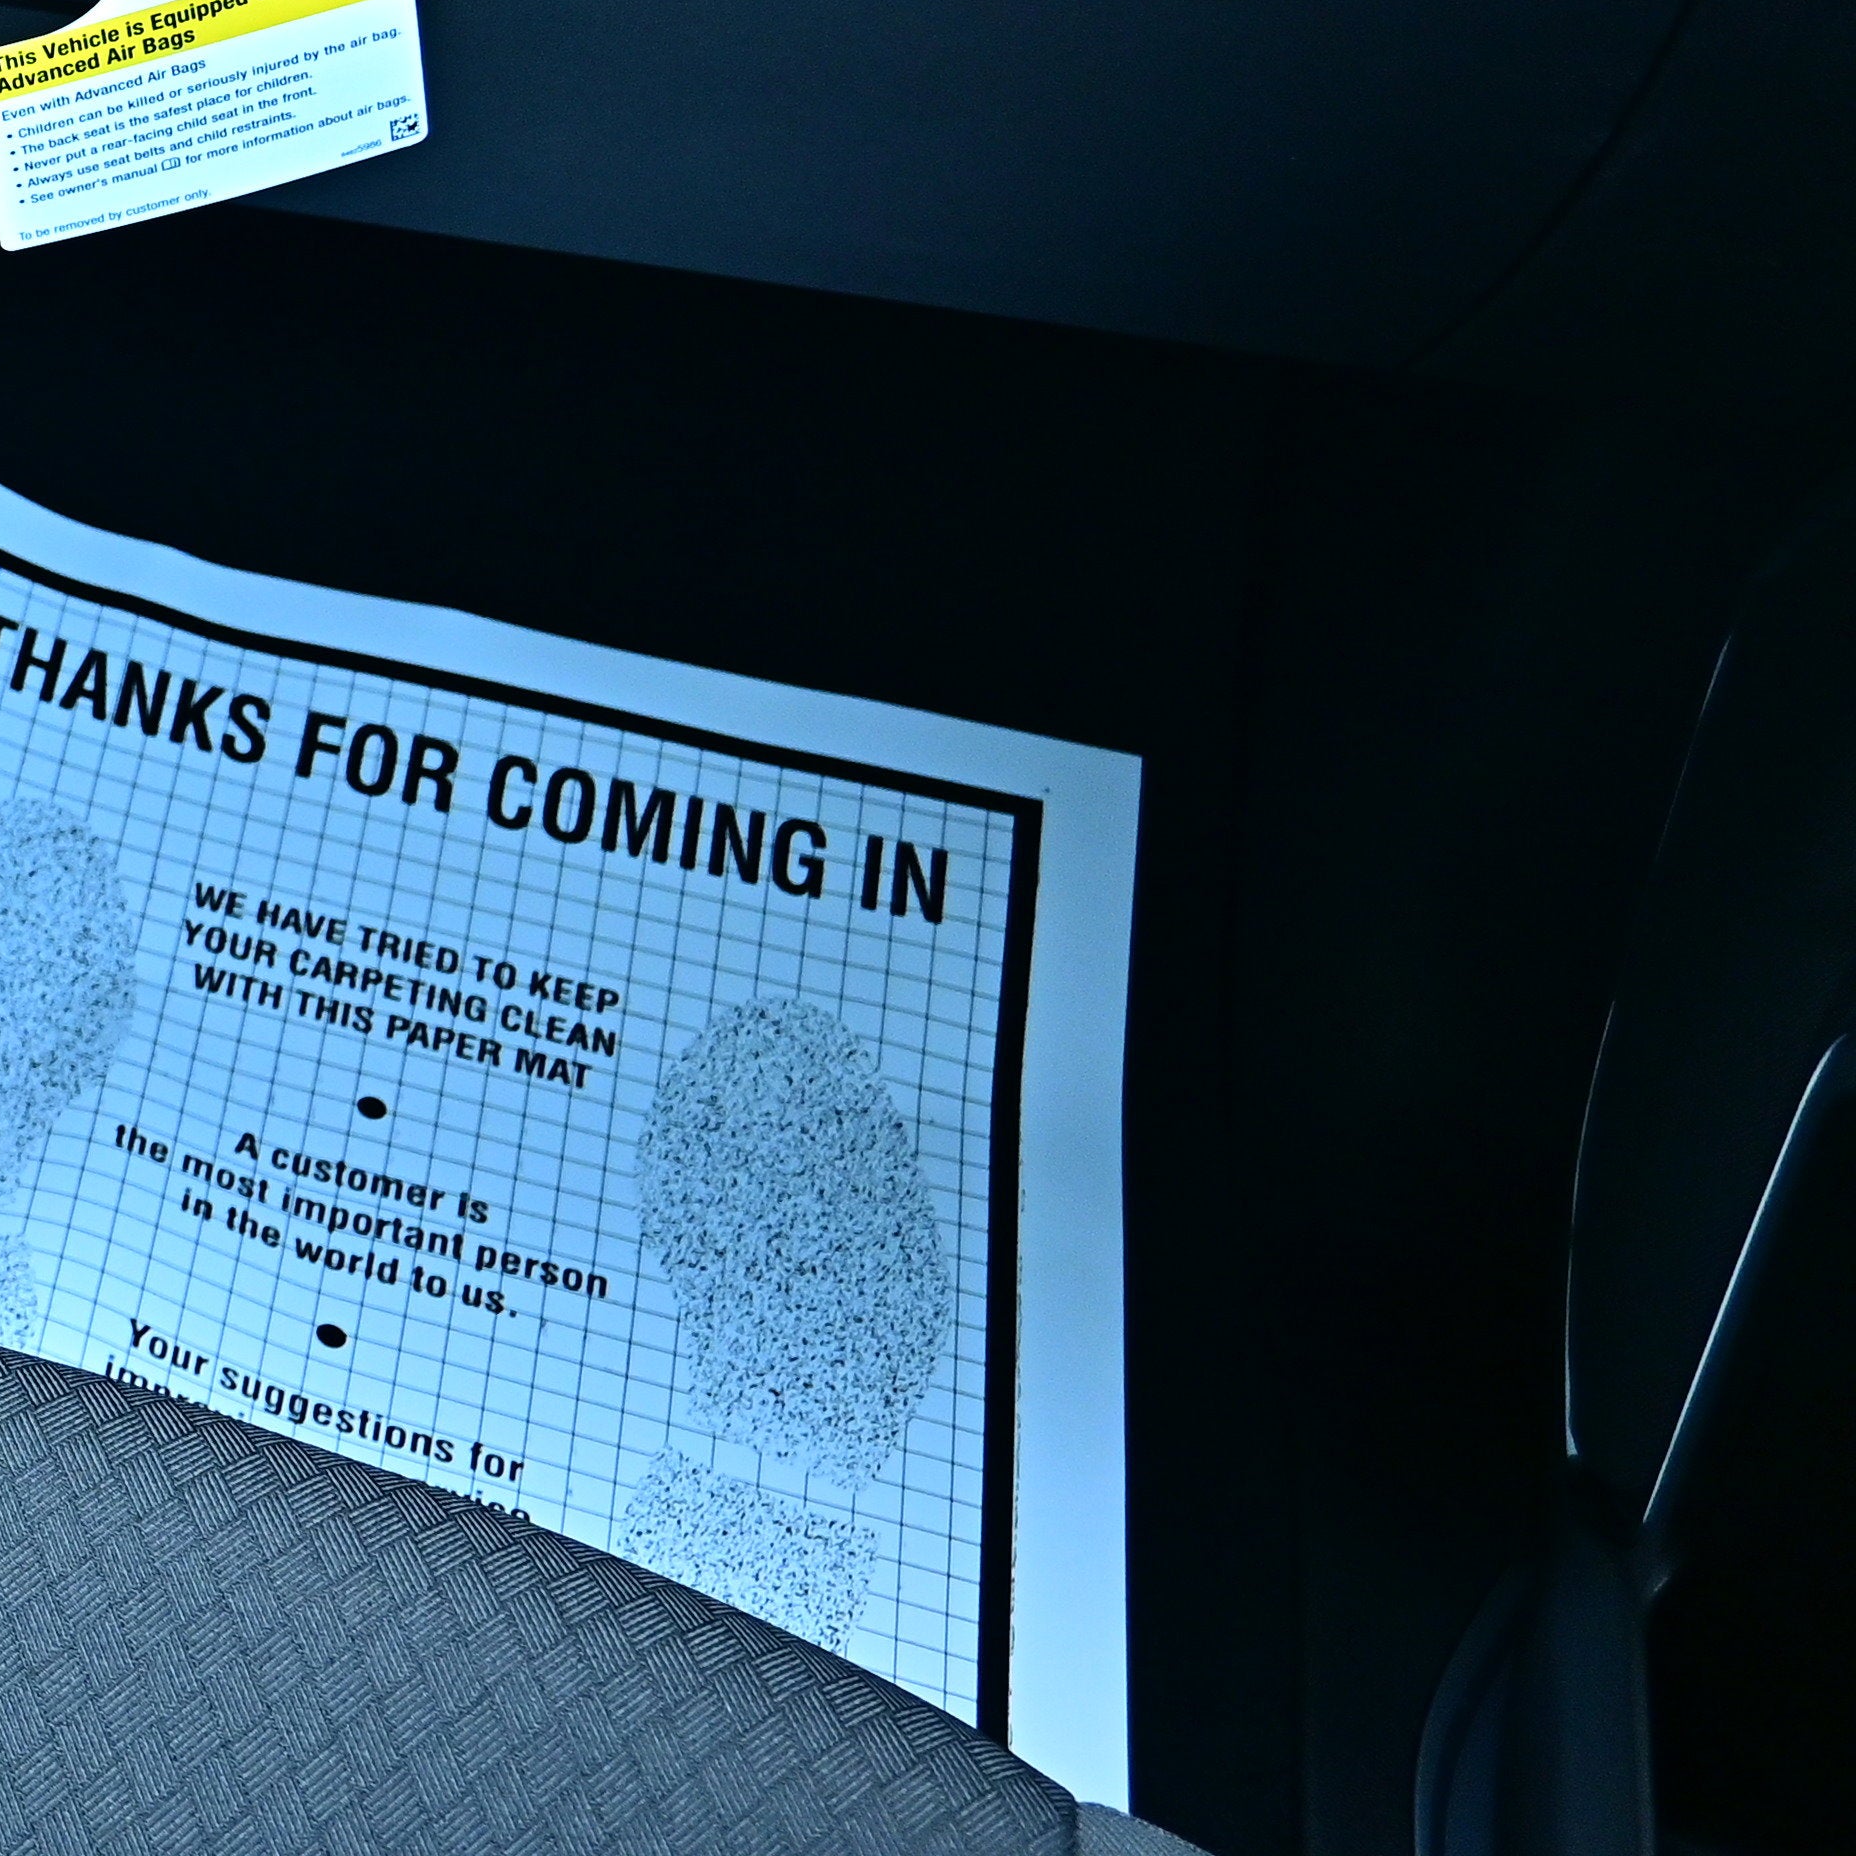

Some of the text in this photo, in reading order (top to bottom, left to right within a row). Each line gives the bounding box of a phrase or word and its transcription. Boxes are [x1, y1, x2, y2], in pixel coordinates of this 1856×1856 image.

[1, 59, 206, 122] Even with Advanced Air Bags
[18, 26, 402, 139] Children can be killed or seriously injured by the air bag.
[42, 28, 119, 59] Vehicle
[125, 21, 145, 37] is
[107, 44, 136, 65] Air
[142, 29, 196, 55] Bags
[21, 70, 313, 156] The back seat is the safest place for children.
[24, 87, 317, 172] Never put a rear-facing child seat in the front.
[27, 111, 296, 189] Always use seat belts and child restraints.
[30, 95, 411, 205] See owner's manual for more information about air bags.
[19, 187, 212, 241] To be removed by customer only.
[294, 710, 460, 813] FOR
[487, 753, 828, 900] COMING
[859, 834, 949, 925] IN
[182, 918, 618, 1058] YOUR CARPETING CLEAN
[194, 882, 620, 1015] WE HAVE TRIED TO KEEP
[193, 962, 594, 1089] WITH THIS PAPER MAT
[115, 1123, 610, 1299] the most important person
[233, 1132, 489, 1224] A customer is
[180, 1187, 518, 1318] in the world to us.
[129, 1317, 209, 1376] Your
[220, 1365, 455, 1463] suggestions
[469, 1442, 526, 1483] for
